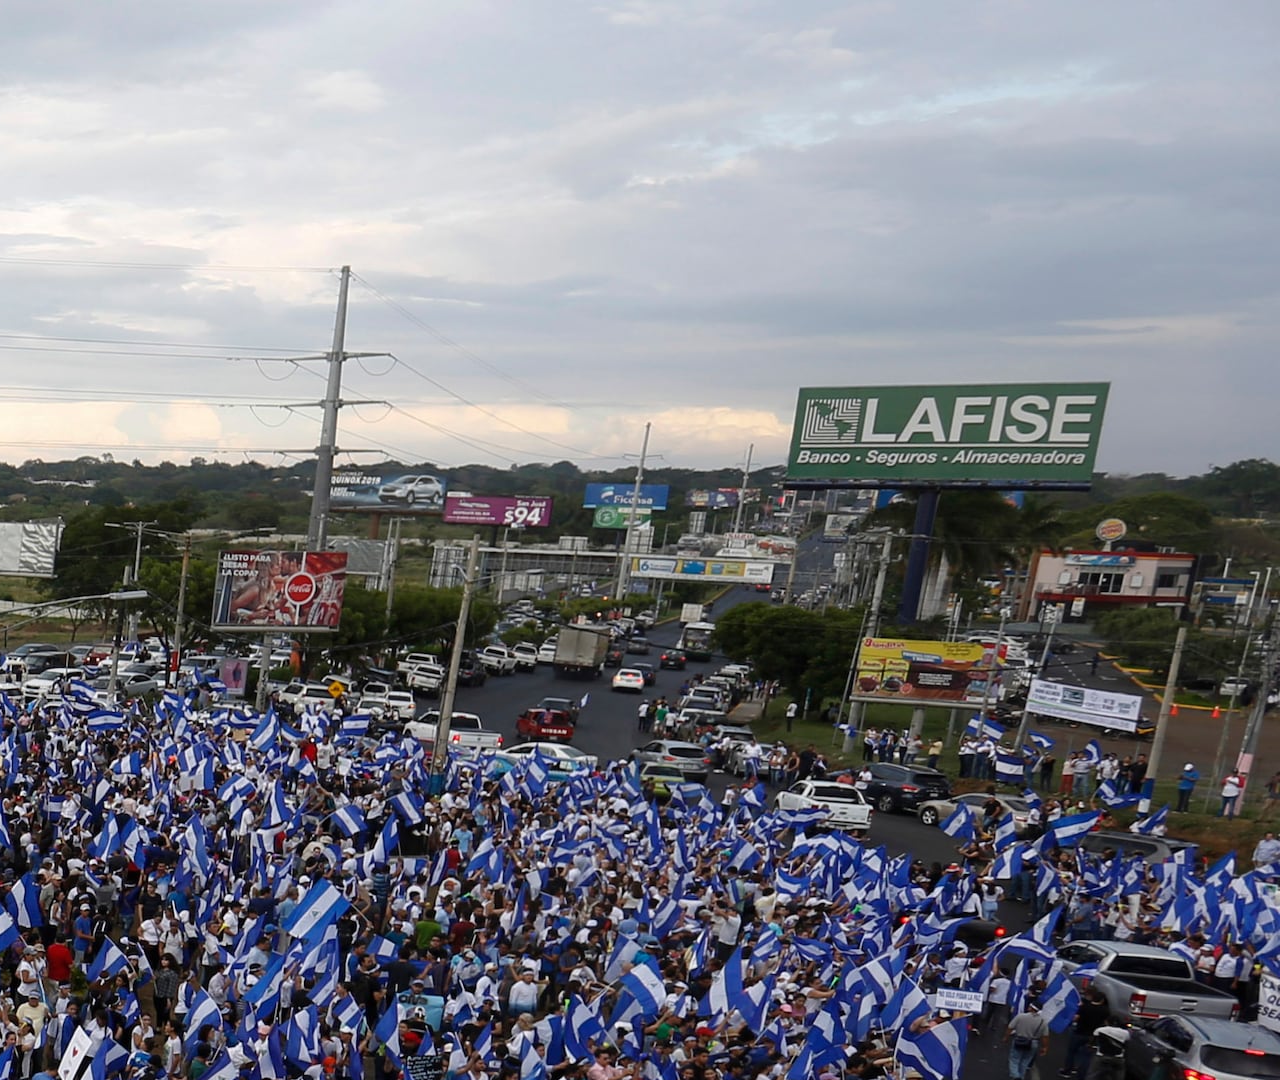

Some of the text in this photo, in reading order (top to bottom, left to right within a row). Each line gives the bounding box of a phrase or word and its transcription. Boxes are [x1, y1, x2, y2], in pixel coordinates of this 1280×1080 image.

[860, 395, 1098, 444] LAFISE
[796, 449, 1086, 466] Banco Seguros Almacenadora
[250, 554, 272, 562] PARA
[233, 569, 259, 577] COPA?
[541, 727, 568, 735] NISSAN
